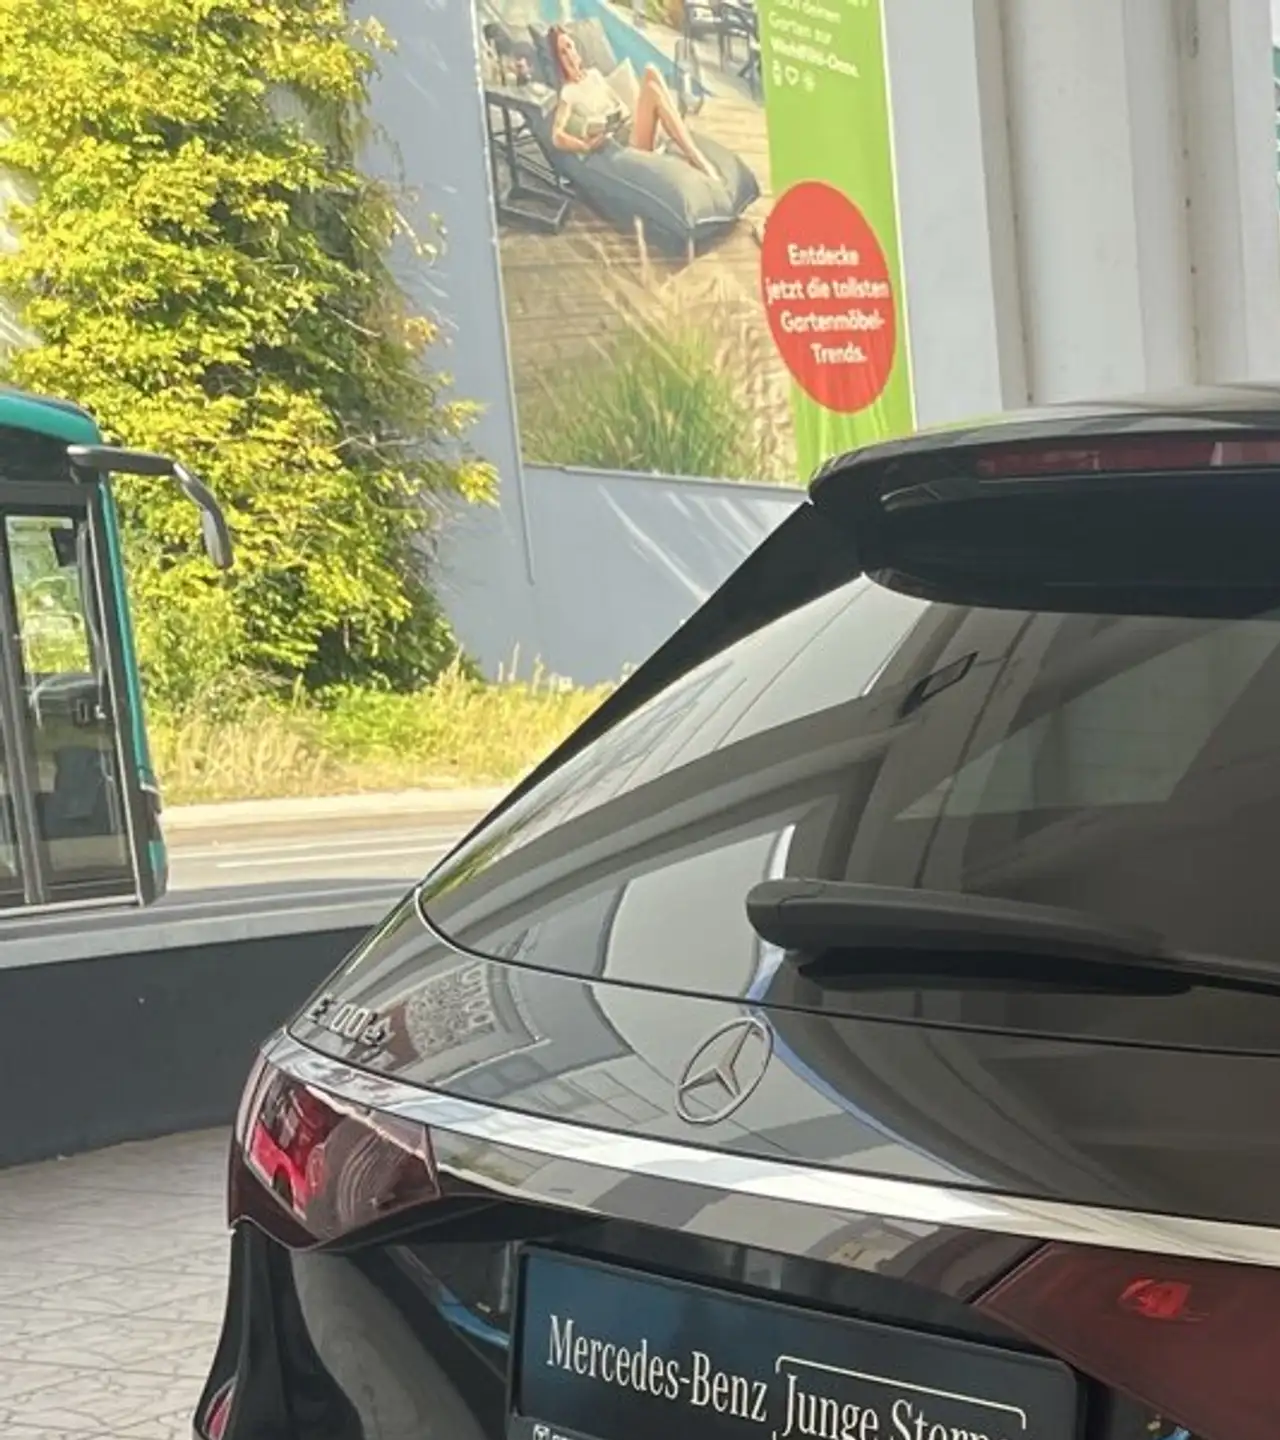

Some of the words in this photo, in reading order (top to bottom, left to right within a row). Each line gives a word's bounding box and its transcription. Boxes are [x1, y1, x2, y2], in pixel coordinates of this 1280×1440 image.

[787, 243, 860, 266] Entdecke
[765, 277, 805, 305] jetzt
[806, 276, 831, 300] die
[780, 308, 886, 333] Gartenmöbel-
[809, 341, 868, 365] Trends.
[546, 1314, 768, 1423] Mercedes-Benz
